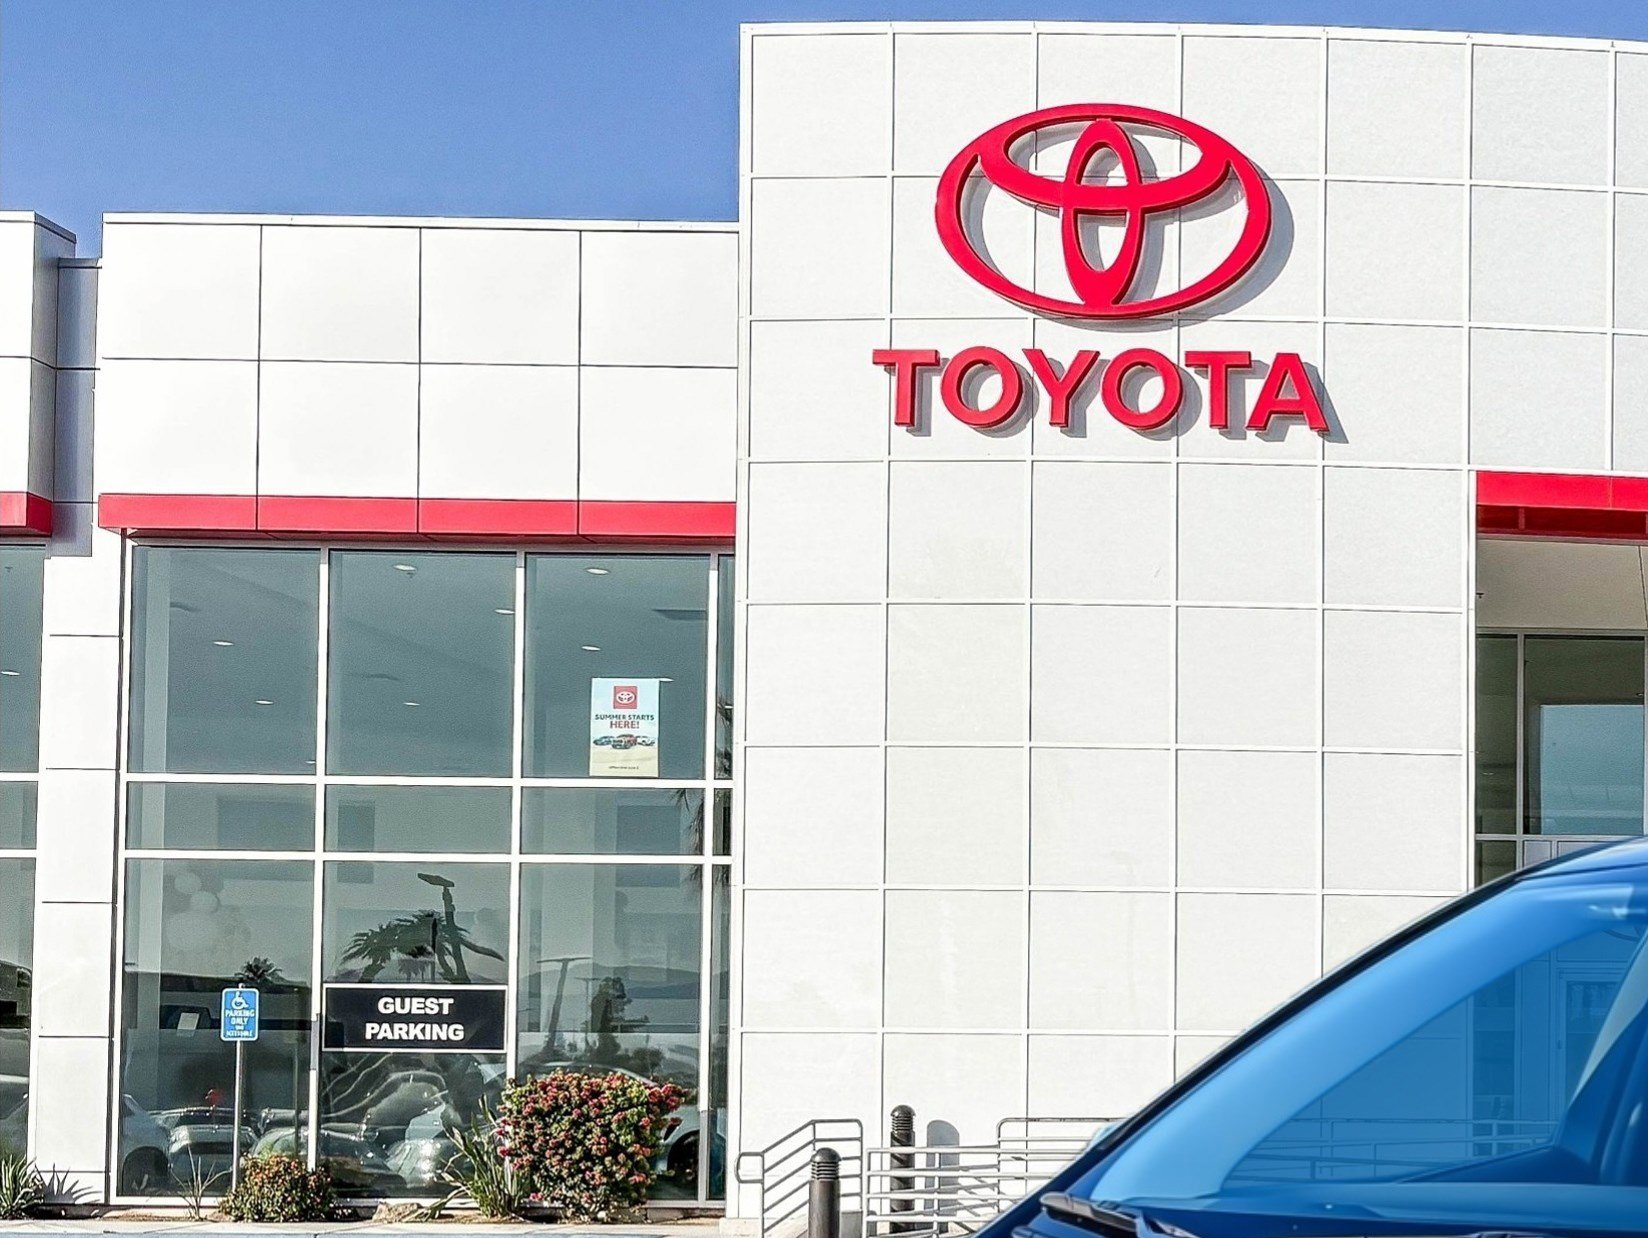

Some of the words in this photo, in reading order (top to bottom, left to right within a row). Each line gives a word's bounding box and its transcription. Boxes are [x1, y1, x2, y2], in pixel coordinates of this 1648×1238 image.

[872, 346, 1330, 433] TOYOTA
[609, 720, 640, 729] HERE!
[377, 997, 455, 1015] GUEST
[364, 1022, 465, 1041] PARKING
